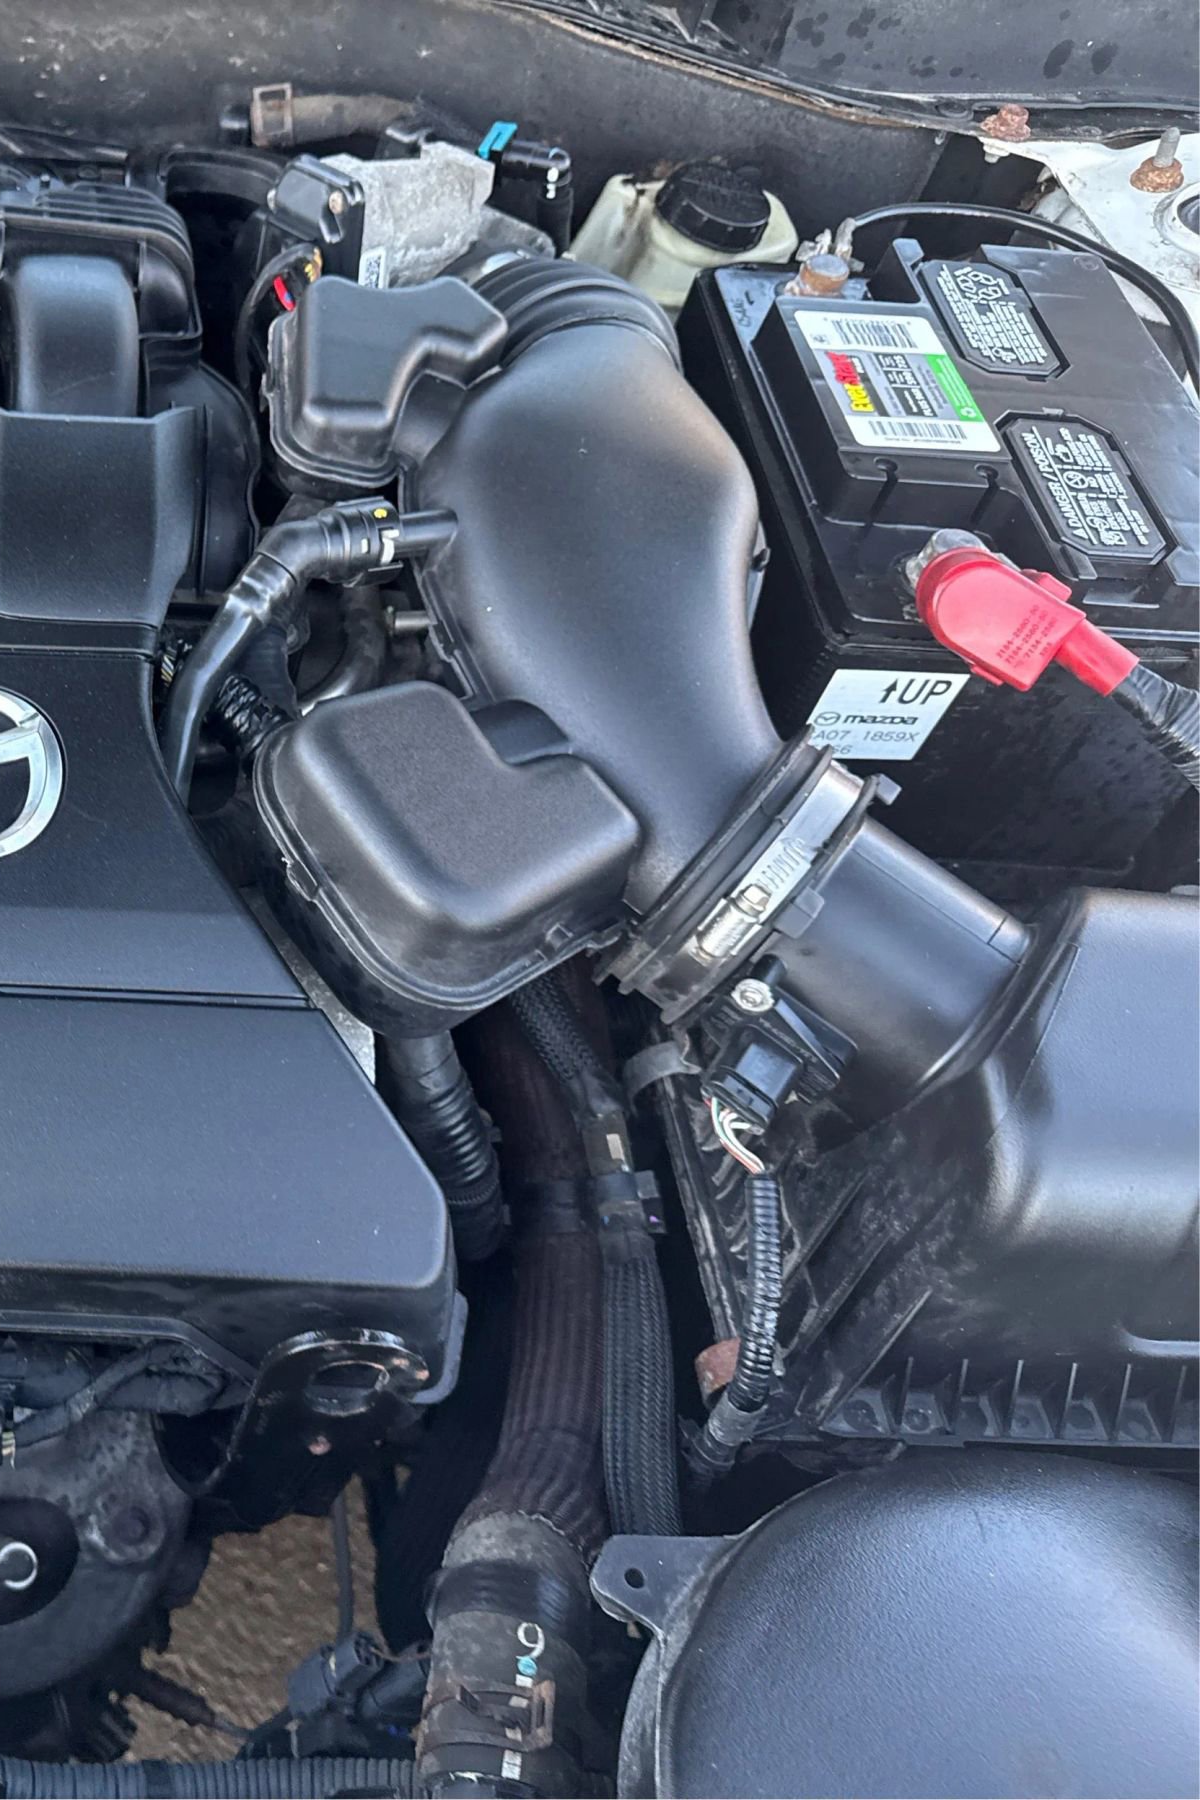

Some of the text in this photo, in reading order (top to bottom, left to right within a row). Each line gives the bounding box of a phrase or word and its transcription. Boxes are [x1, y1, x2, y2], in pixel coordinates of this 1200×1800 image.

[1021, 432, 1053, 473] POISON
[1048, 481, 1082, 529] DANGER
[897, 678, 953, 705] UP
[842, 714, 919, 726] mazda
[863, 730, 921, 742] 1859X
